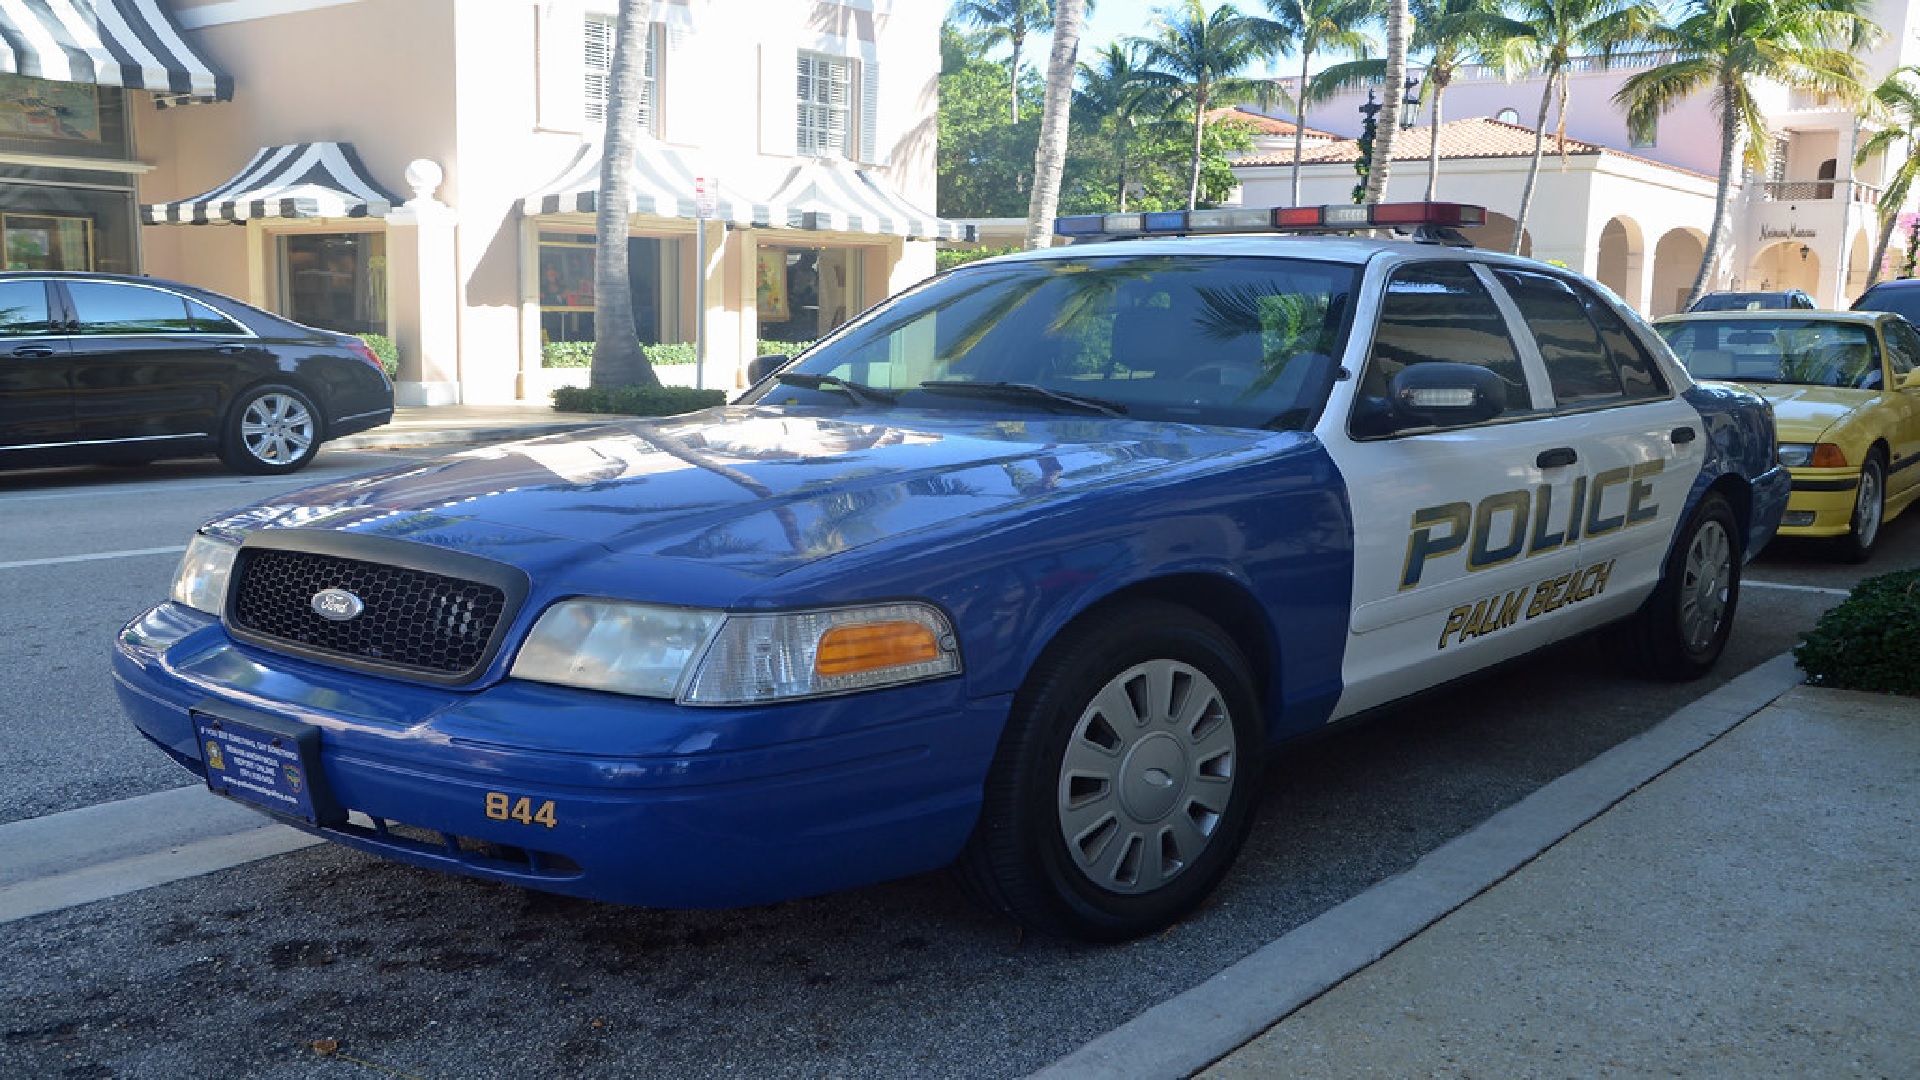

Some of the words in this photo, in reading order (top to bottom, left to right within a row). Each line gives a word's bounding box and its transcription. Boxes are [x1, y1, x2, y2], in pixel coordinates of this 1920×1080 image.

[1399, 459, 1664, 592] POLICE
[1438, 588, 1528, 650] PALM
[1526, 559, 1616, 620] BEACH
[486, 792, 558, 829] 844
